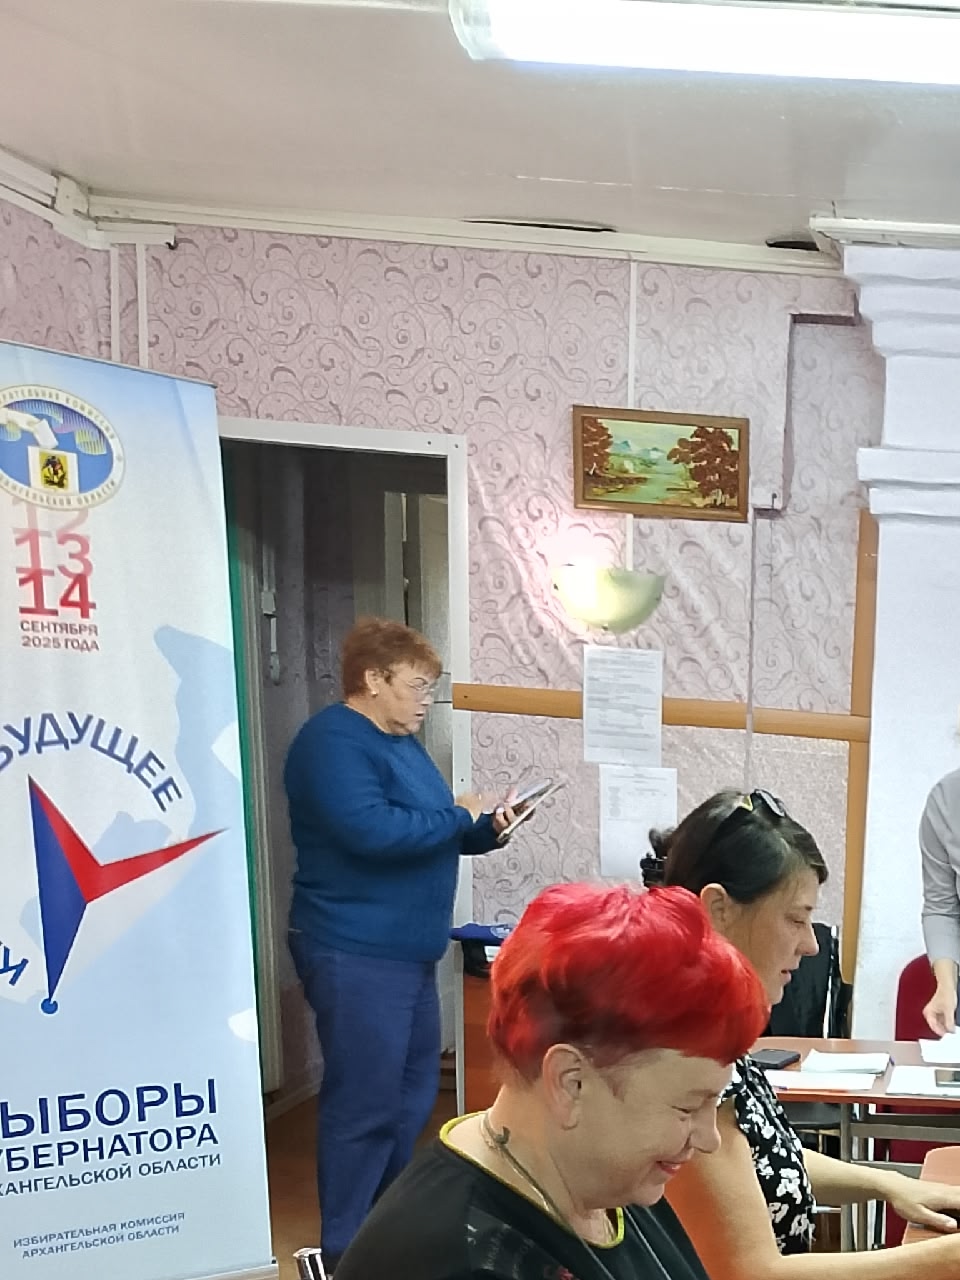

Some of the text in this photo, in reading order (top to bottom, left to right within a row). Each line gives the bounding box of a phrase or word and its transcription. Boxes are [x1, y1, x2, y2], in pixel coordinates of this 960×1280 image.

[16, 529, 94, 580] 13
[19, 569, 97, 619] 14
[20, 620, 99, 637] СЕНТЯБРЯ
[22, 636, 99, 651] 2025 ГОДА
[0, 1079, 217, 1138] ЫБОРЫ
[0, 1123, 219, 1173] БЕРНАТОРА
[138, 1153, 222, 1177] ОБЛАСТИ
[13, 1212, 186, 1249] ИЗБИРАТЕЛЬНАЯ КОМИССИЯ
[22, 1224, 180, 1259] АРХАНГЕЛЬСКОЙ ОБЛАСТИ
